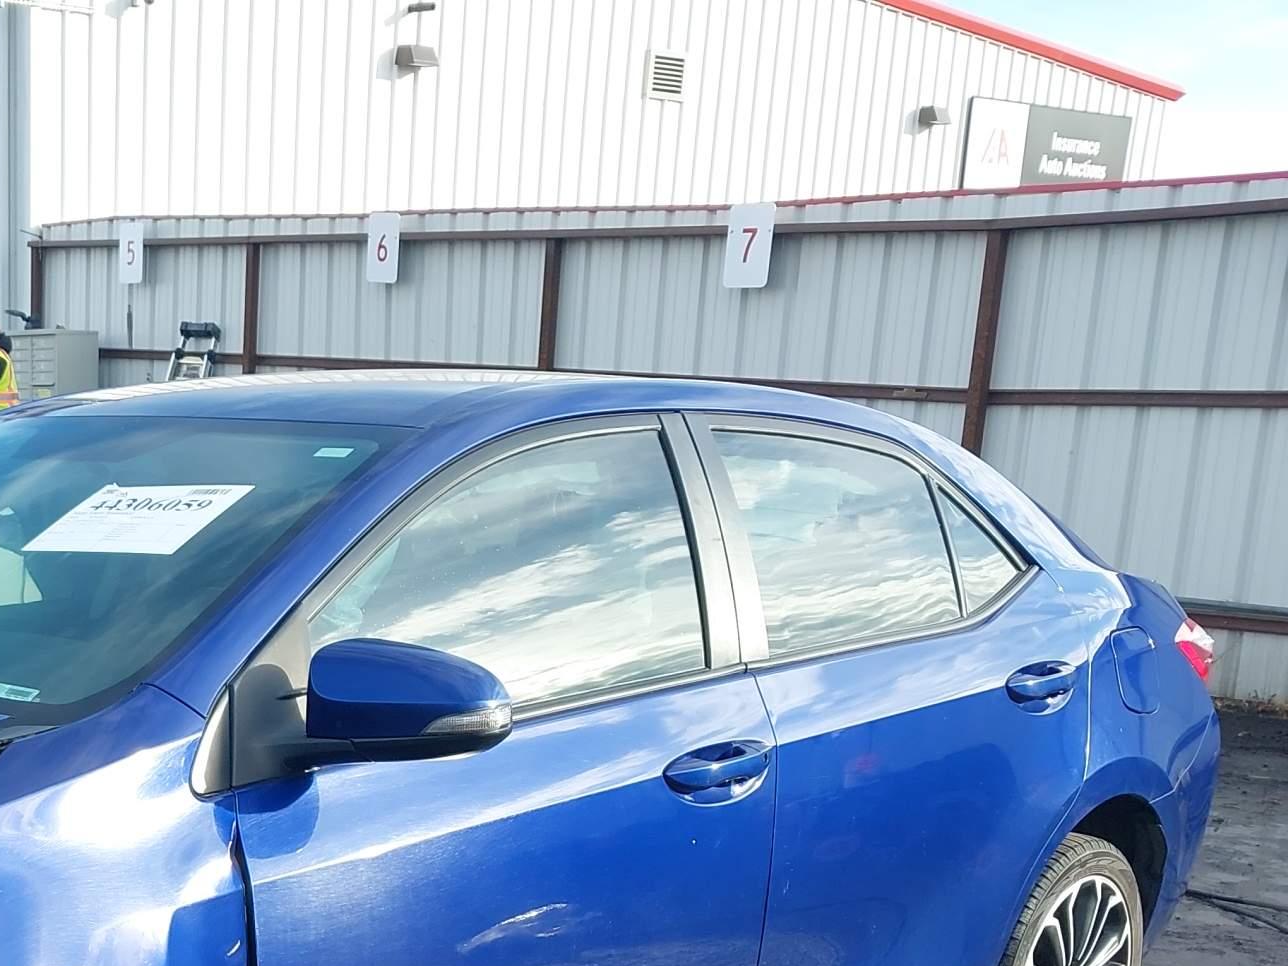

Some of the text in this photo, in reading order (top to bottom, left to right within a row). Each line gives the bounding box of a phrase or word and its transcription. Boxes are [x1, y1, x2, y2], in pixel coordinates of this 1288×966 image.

[1051, 131, 1101, 156] Insurance
[1038, 154, 1108, 180] Auto Auctions
[127, 240, 136, 266] 5
[377, 233, 388, 262] 6
[742, 227, 758, 264] 7
[89, 497, 213, 512] 44306059
